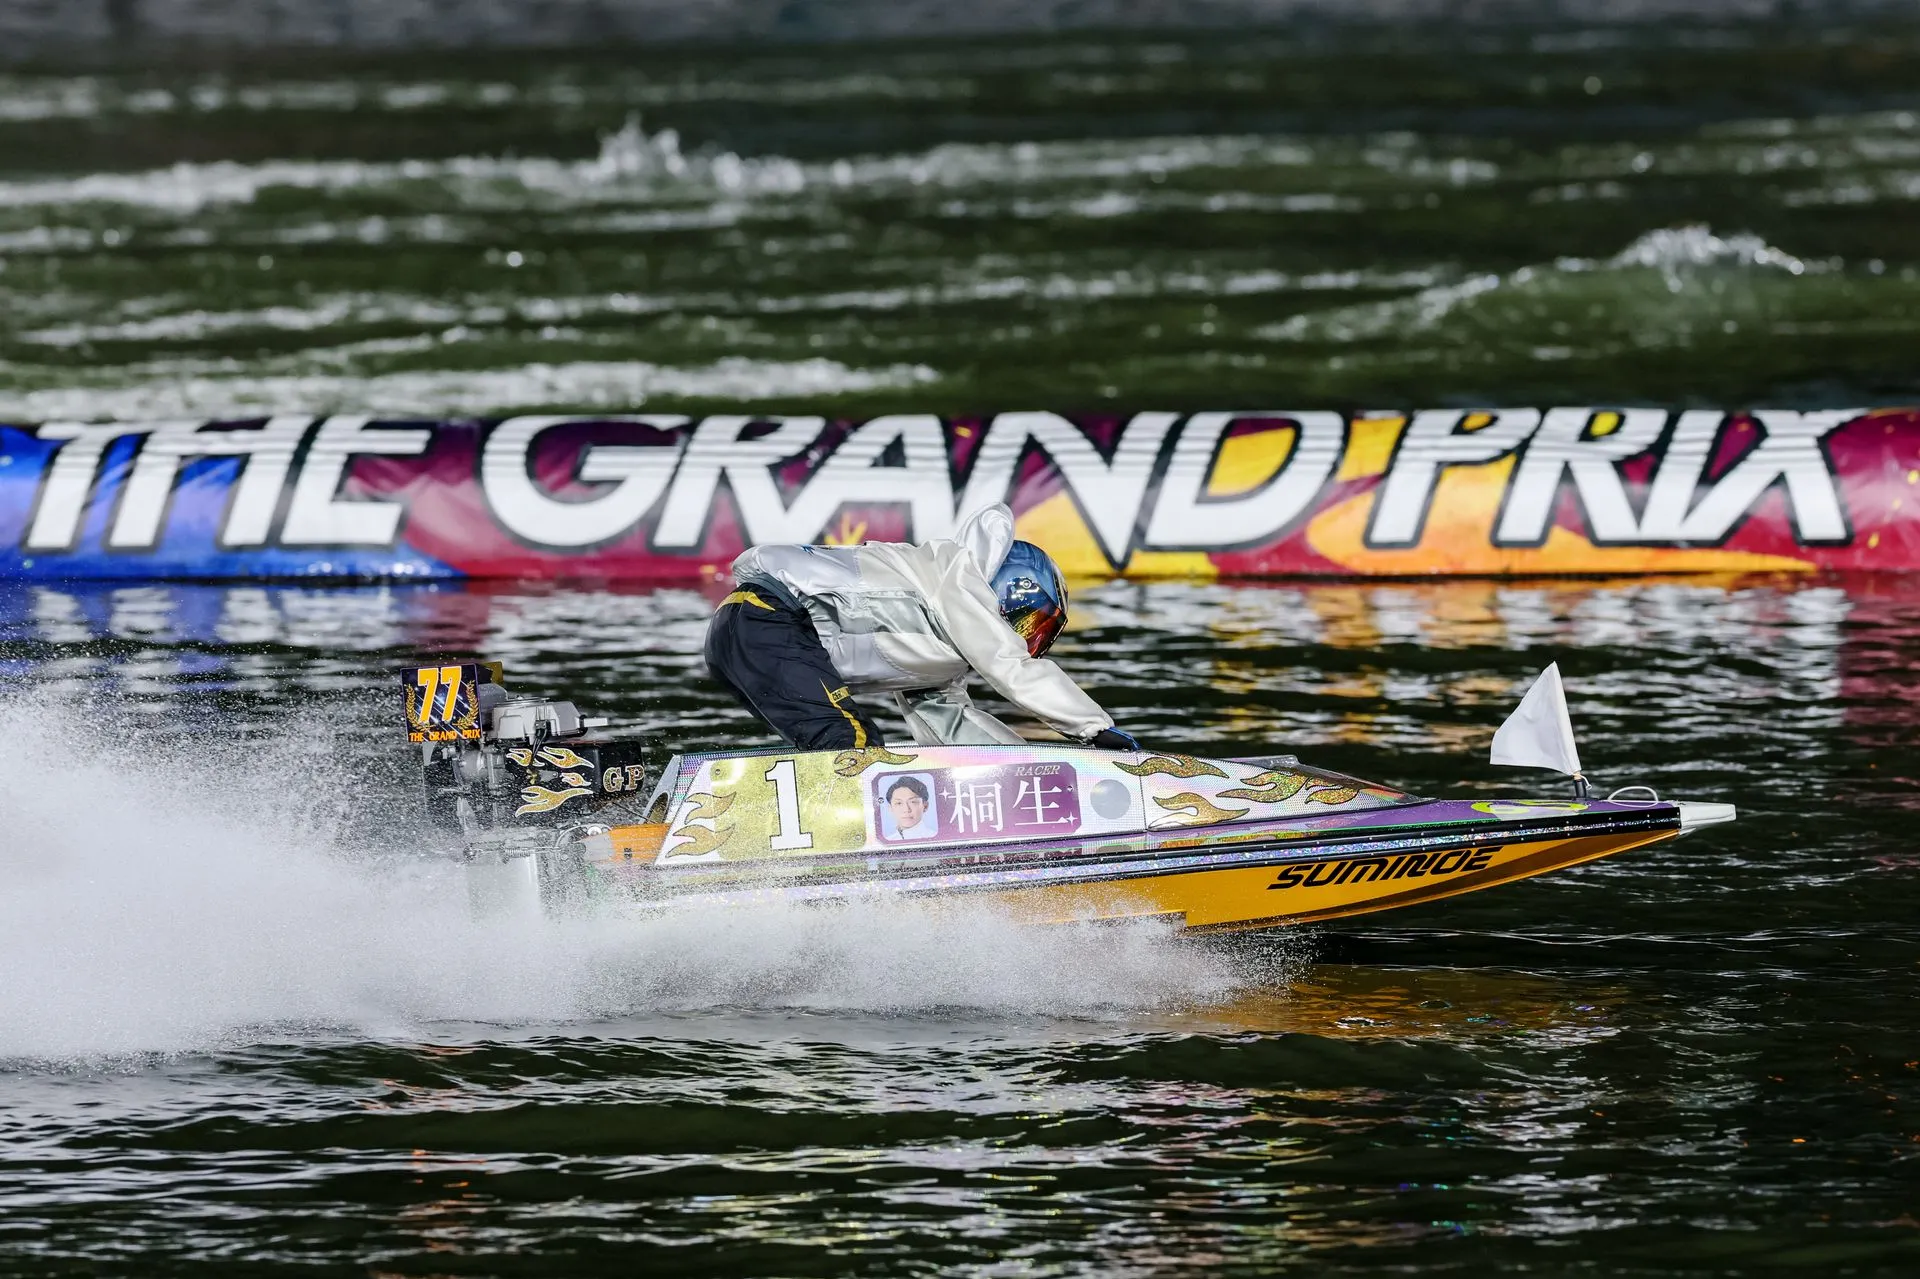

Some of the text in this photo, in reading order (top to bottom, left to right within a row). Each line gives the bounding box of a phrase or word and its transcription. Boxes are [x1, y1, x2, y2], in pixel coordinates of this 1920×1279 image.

[26, 407, 1860, 565] THE GRAND PRIX
[417, 666, 462, 722] 77
[409, 729, 481, 742] THE GRAND PRIX
[602, 765, 645, 793] GP
[1014, 765, 1061, 777] RACER
[764, 759, 814, 850] 1
[948, 777, 1068, 833] 桐生
[1267, 846, 1504, 891] SUMINOE
